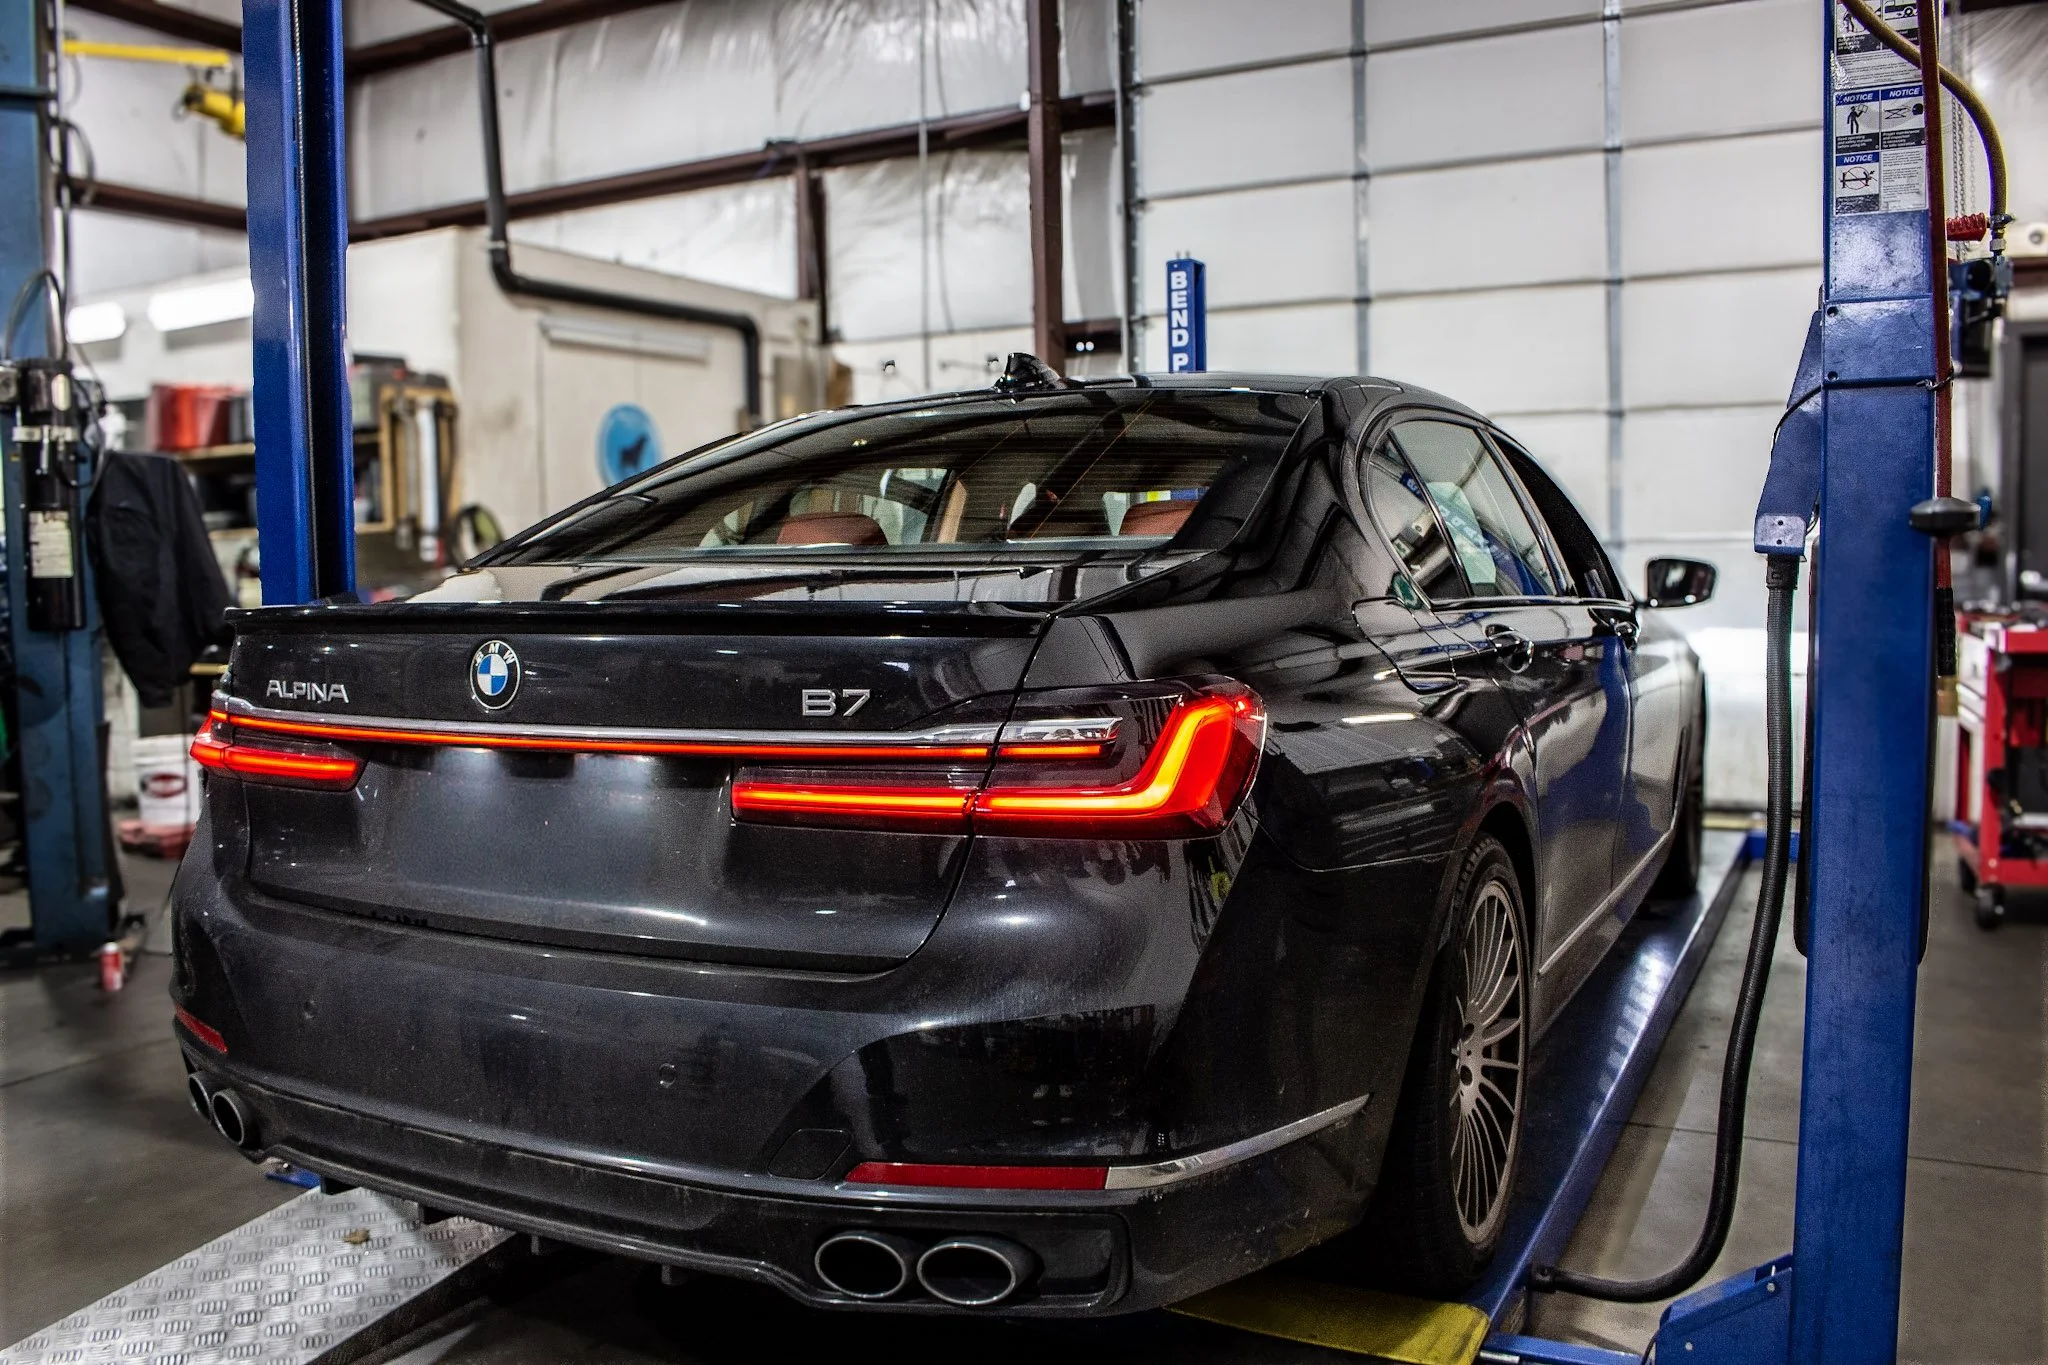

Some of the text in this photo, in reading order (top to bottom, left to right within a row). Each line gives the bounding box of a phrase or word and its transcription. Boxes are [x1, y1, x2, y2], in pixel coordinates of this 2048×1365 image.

[1843, 93, 1874, 103] NOTICE
[1889, 88, 1920, 97] NOTICE
[1843, 154, 1874, 163] NOTICE
[1171, 270, 1189, 348] BEND
[475, 642, 516, 667] BMW
[266, 680, 350, 704] ALPINA
[802, 689, 871, 717] B7
